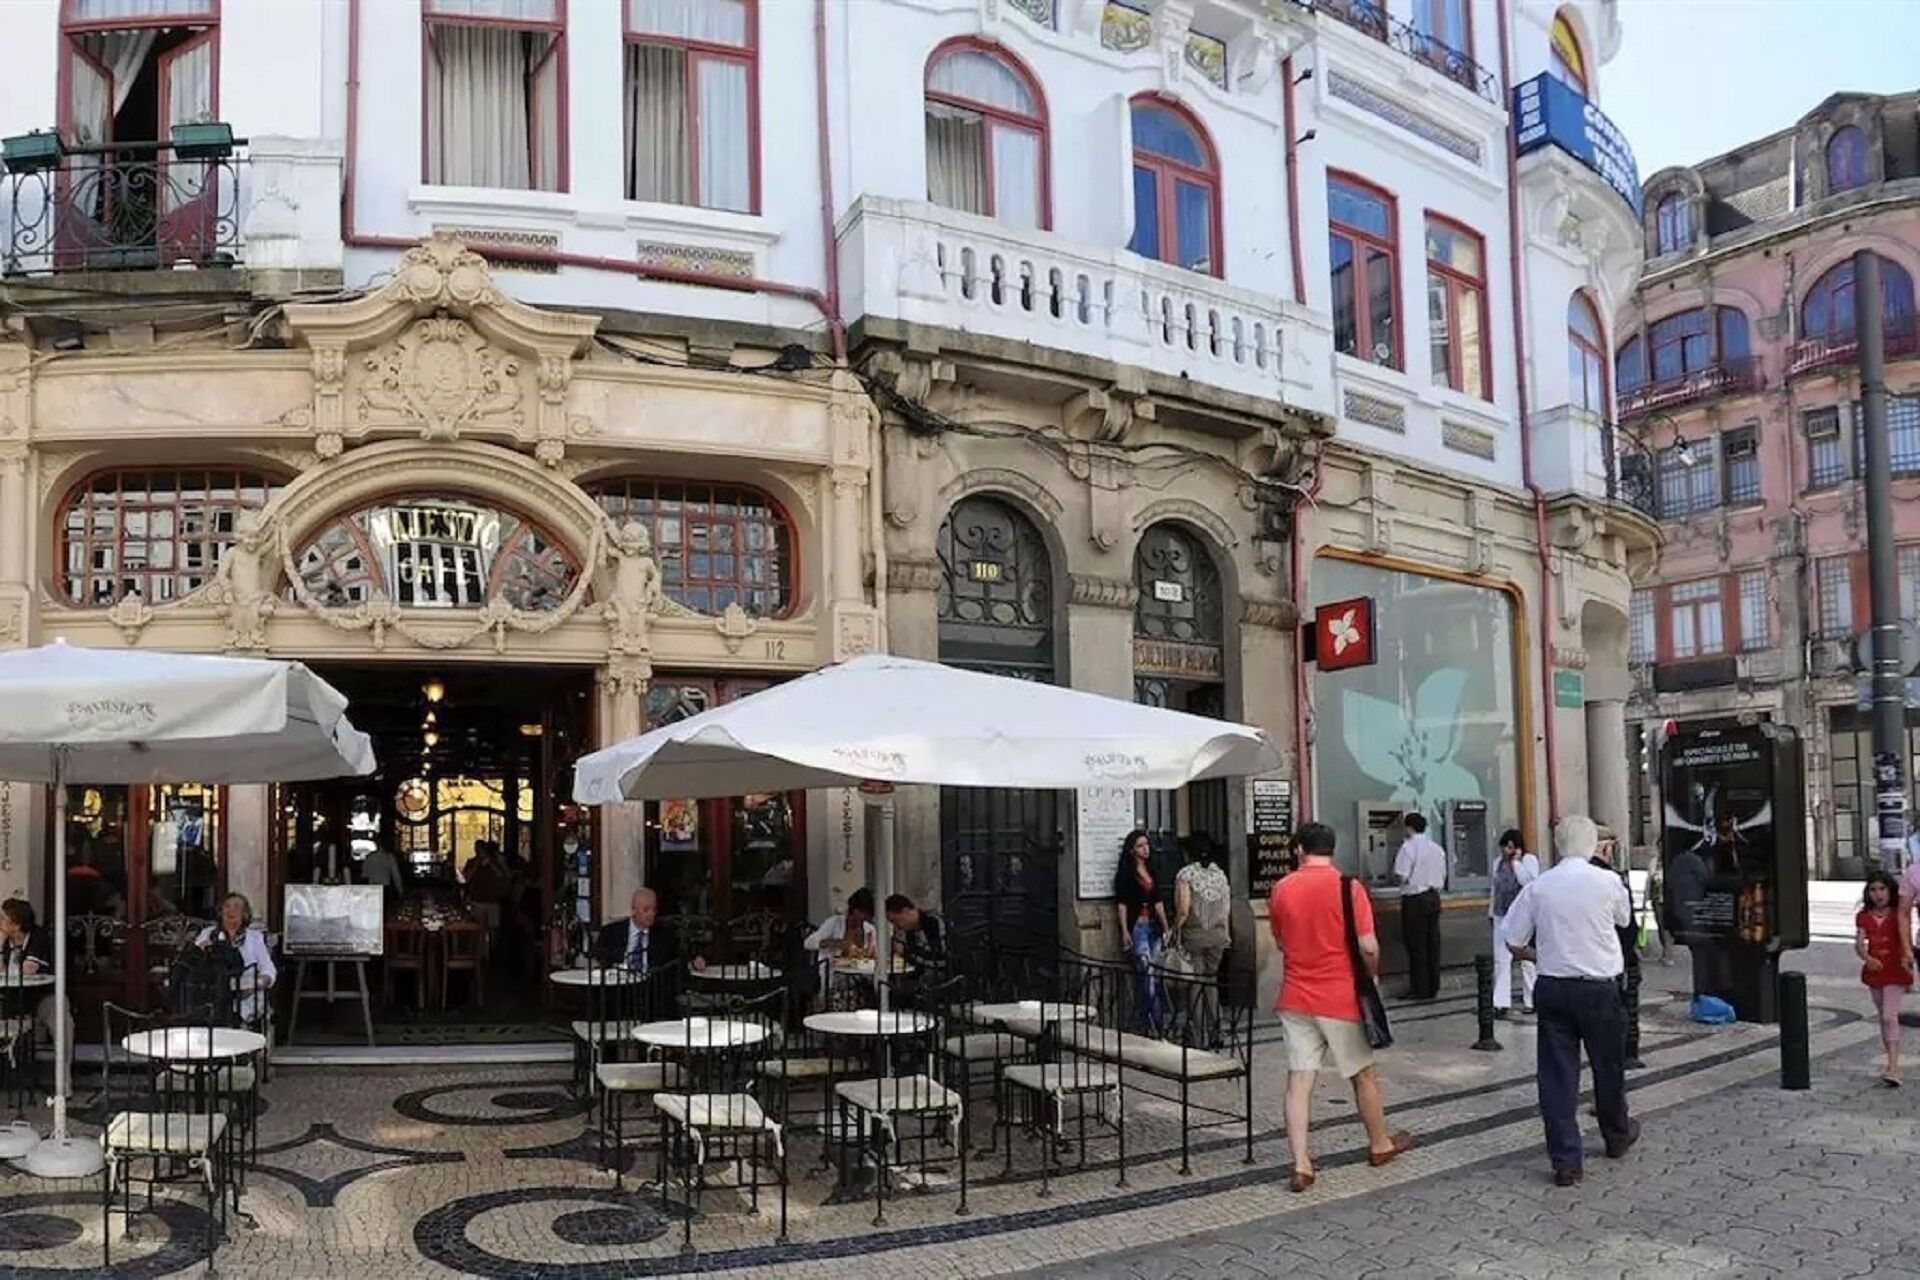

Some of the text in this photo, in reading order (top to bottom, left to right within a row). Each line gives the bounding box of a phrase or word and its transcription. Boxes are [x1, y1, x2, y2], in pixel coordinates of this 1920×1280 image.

[370, 508, 500, 550] MAJESTIC
[400, 551, 475, 584] CAFÉ
[975, 562, 998, 579] 110
[765, 640, 785, 660] 112
[1, 780, 12, 872] AJESTIC
[842, 786, 853, 873] AJESTIC
[1259, 834, 1290, 847] OURO
